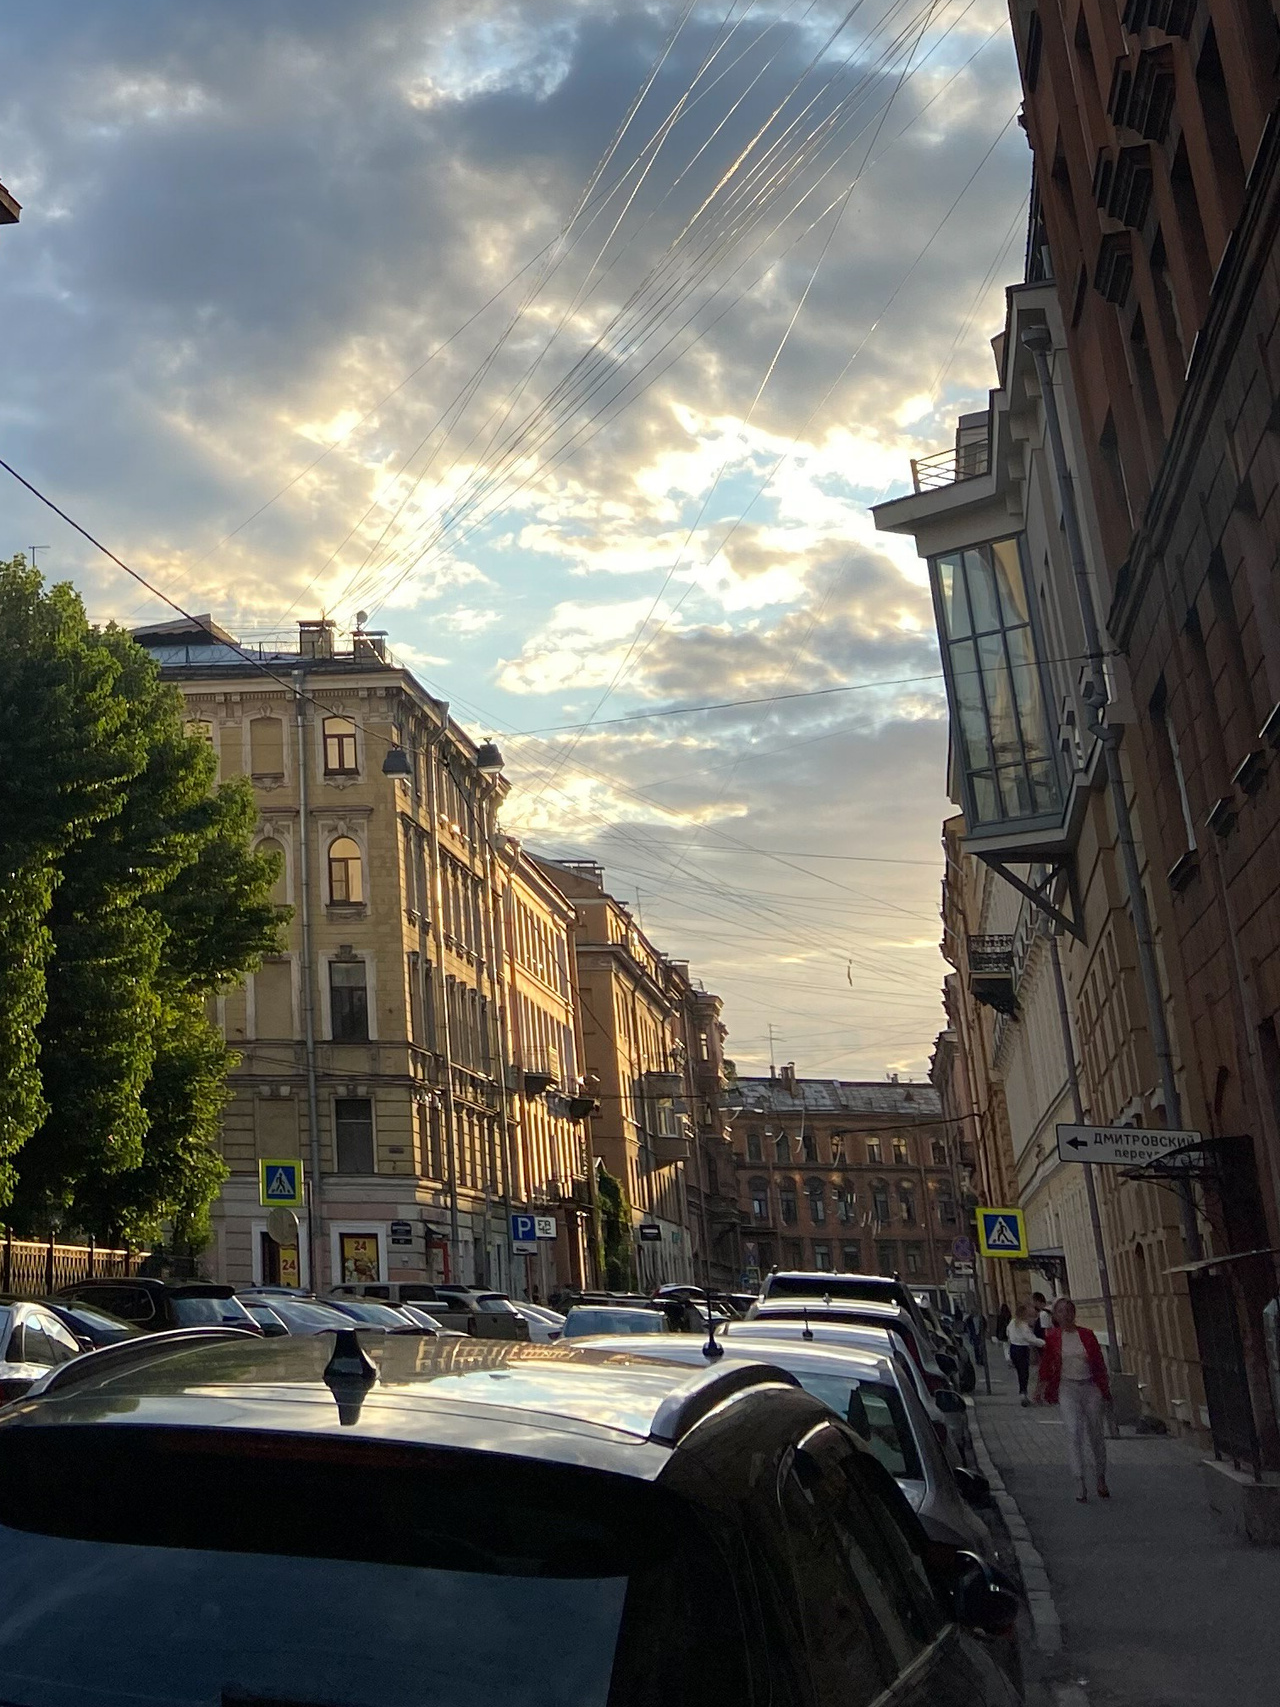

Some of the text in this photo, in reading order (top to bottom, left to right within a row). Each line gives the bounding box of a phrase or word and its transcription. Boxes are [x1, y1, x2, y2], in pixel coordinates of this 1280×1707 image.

[1093, 1133, 1195, 1148] ДМИТРОВСКИЙ
[518, 1217, 531, 1238] P
[354, 1240, 367, 1251] 24
[282, 1259, 296, 1271] 24
